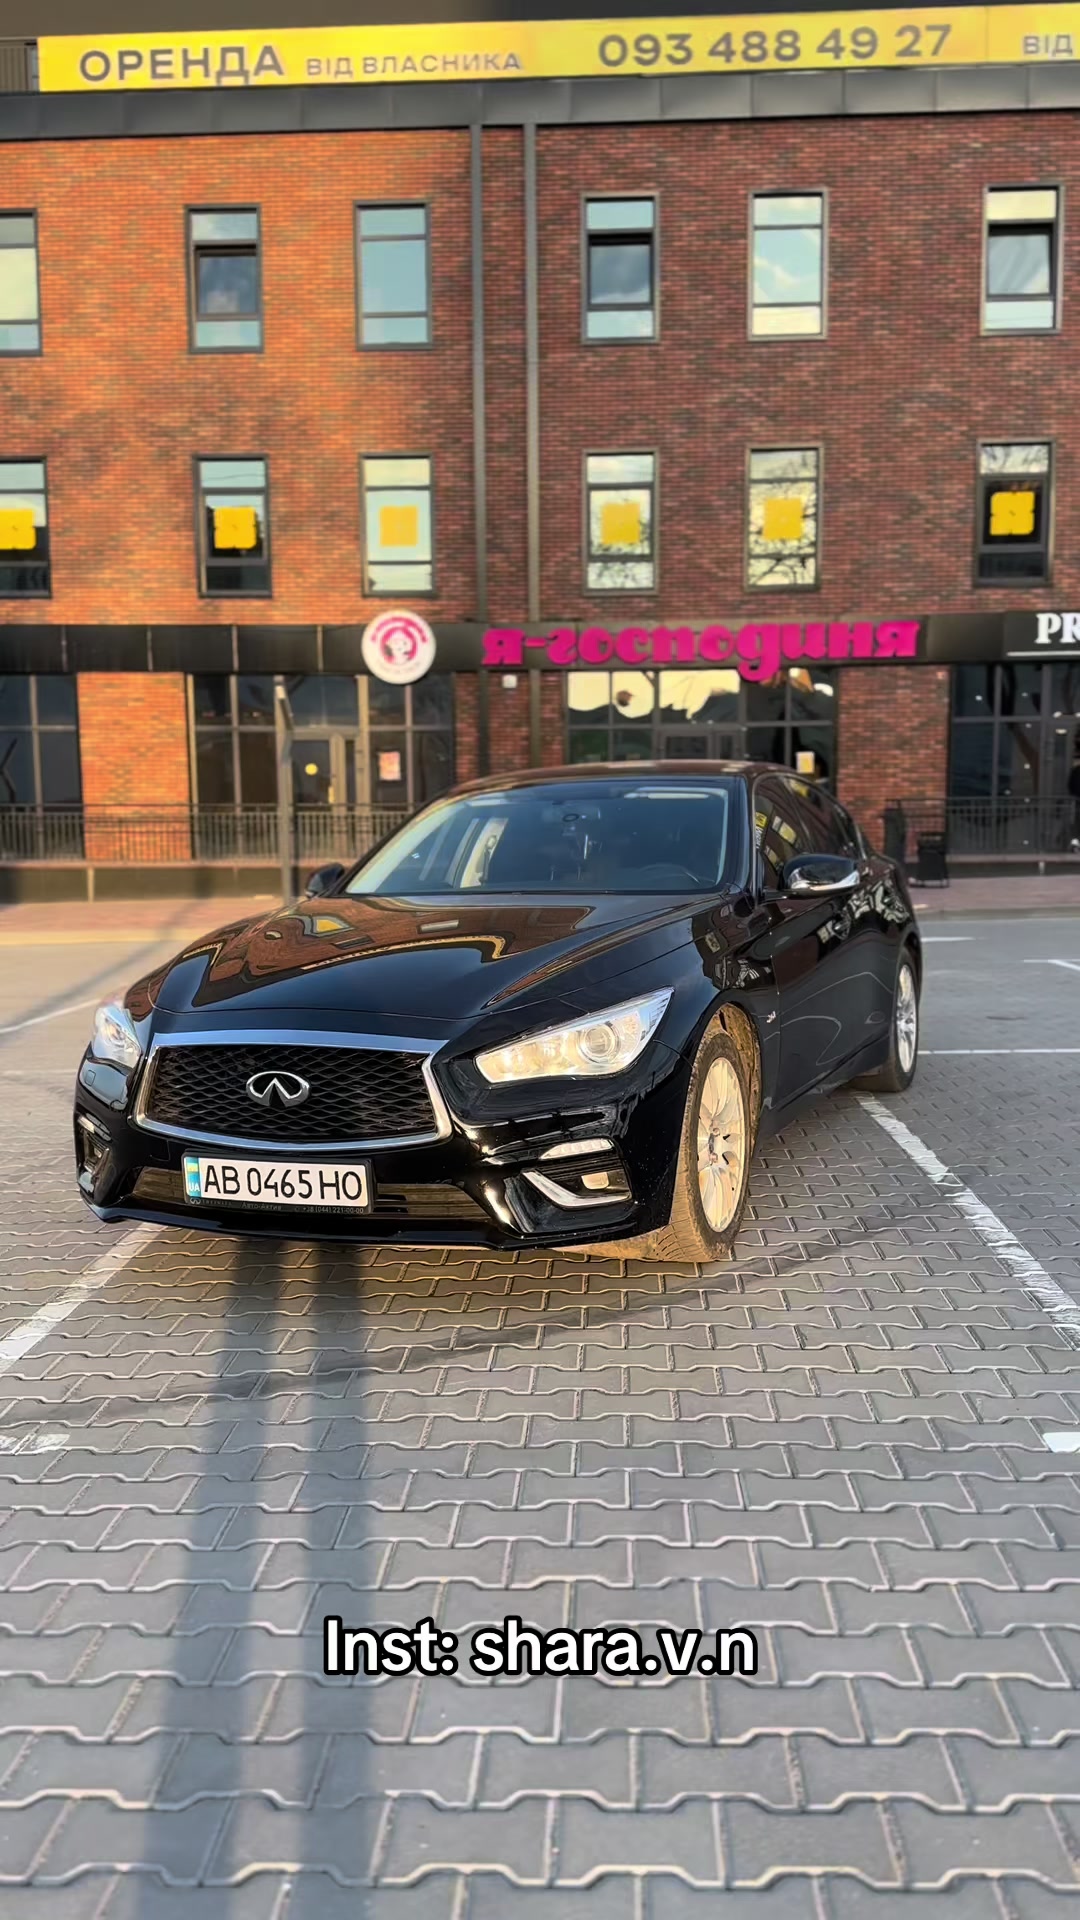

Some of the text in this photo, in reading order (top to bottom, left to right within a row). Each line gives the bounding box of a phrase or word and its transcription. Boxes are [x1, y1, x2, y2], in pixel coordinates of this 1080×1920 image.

[79, 24, 1073, 86] ОРЕНДА ВІД ВЛАСНИКА 093 488 49 27 ВІД
[188, 1183, 201, 1192] UA
[204, 1165, 363, 1201] AB 0465 HO
